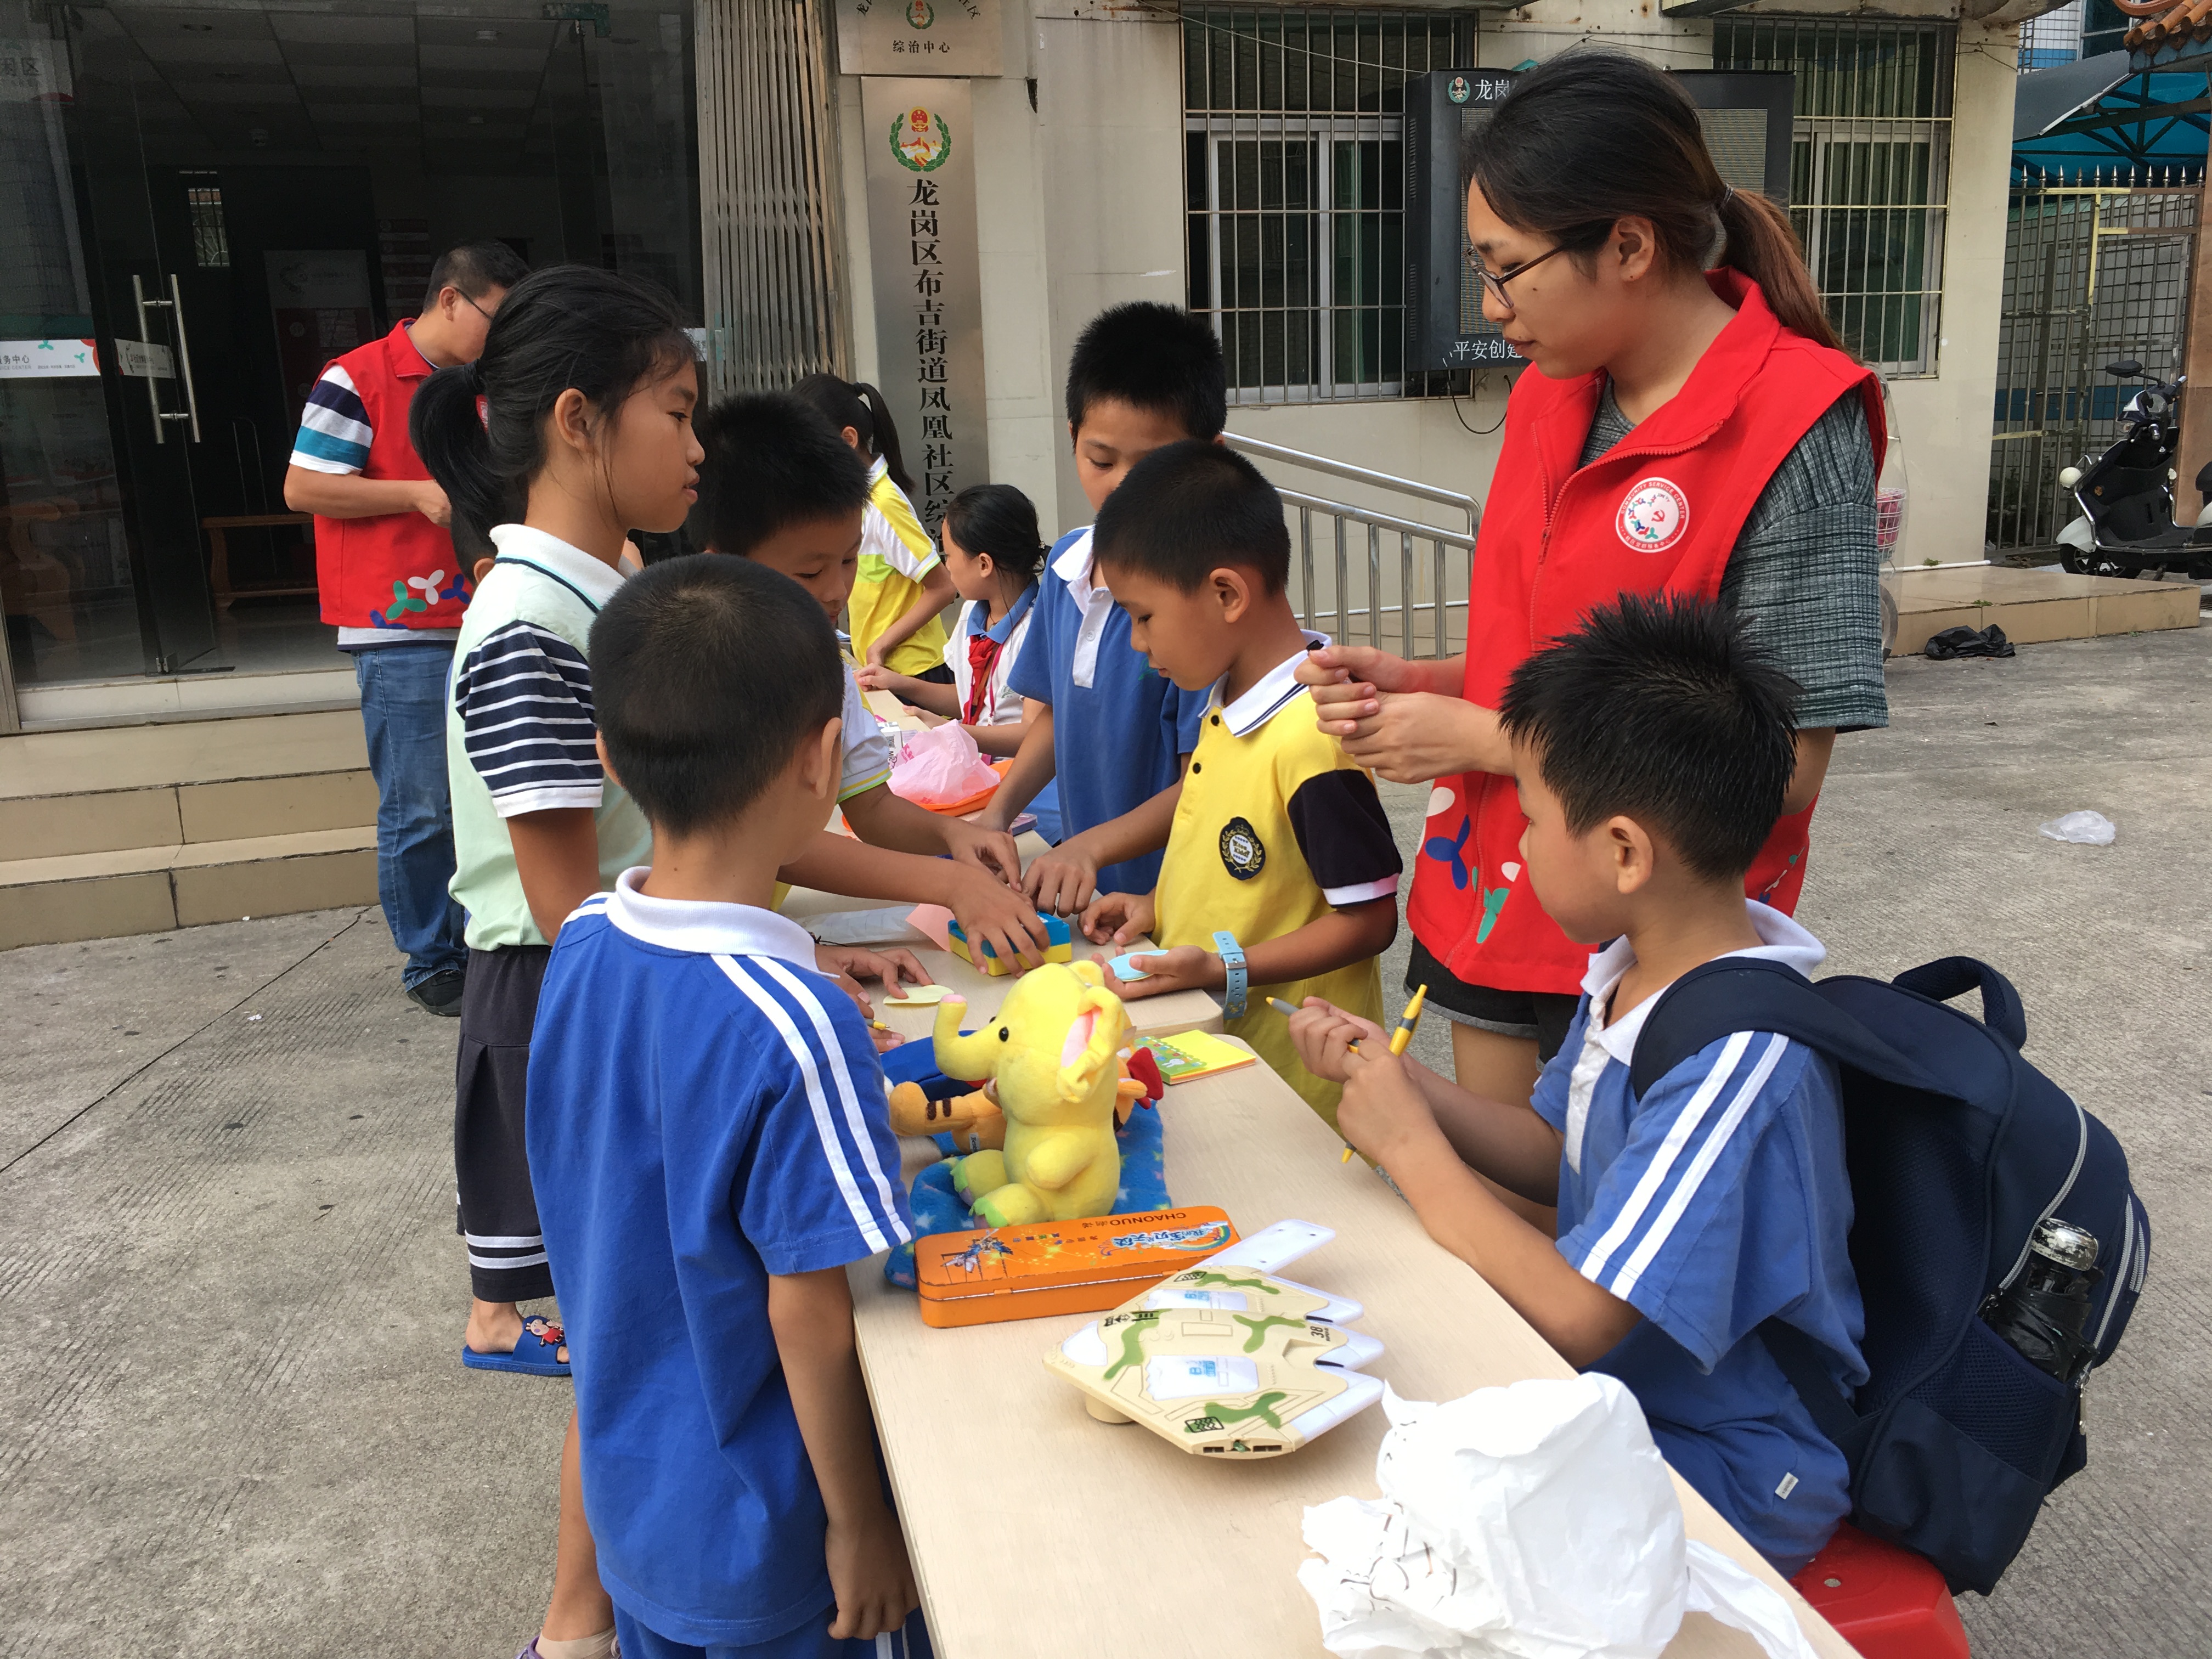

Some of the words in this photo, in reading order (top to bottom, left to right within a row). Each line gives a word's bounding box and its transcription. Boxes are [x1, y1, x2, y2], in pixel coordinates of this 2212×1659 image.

[892, 40, 950, 54] 综治中心
[1621, 483, 1647, 514] COMMUNITY
[1649, 482, 1674, 494] SERVICE
[1673, 493, 1685, 519] CENTER
[1109, 1212, 1186, 1226] CHAONUO
